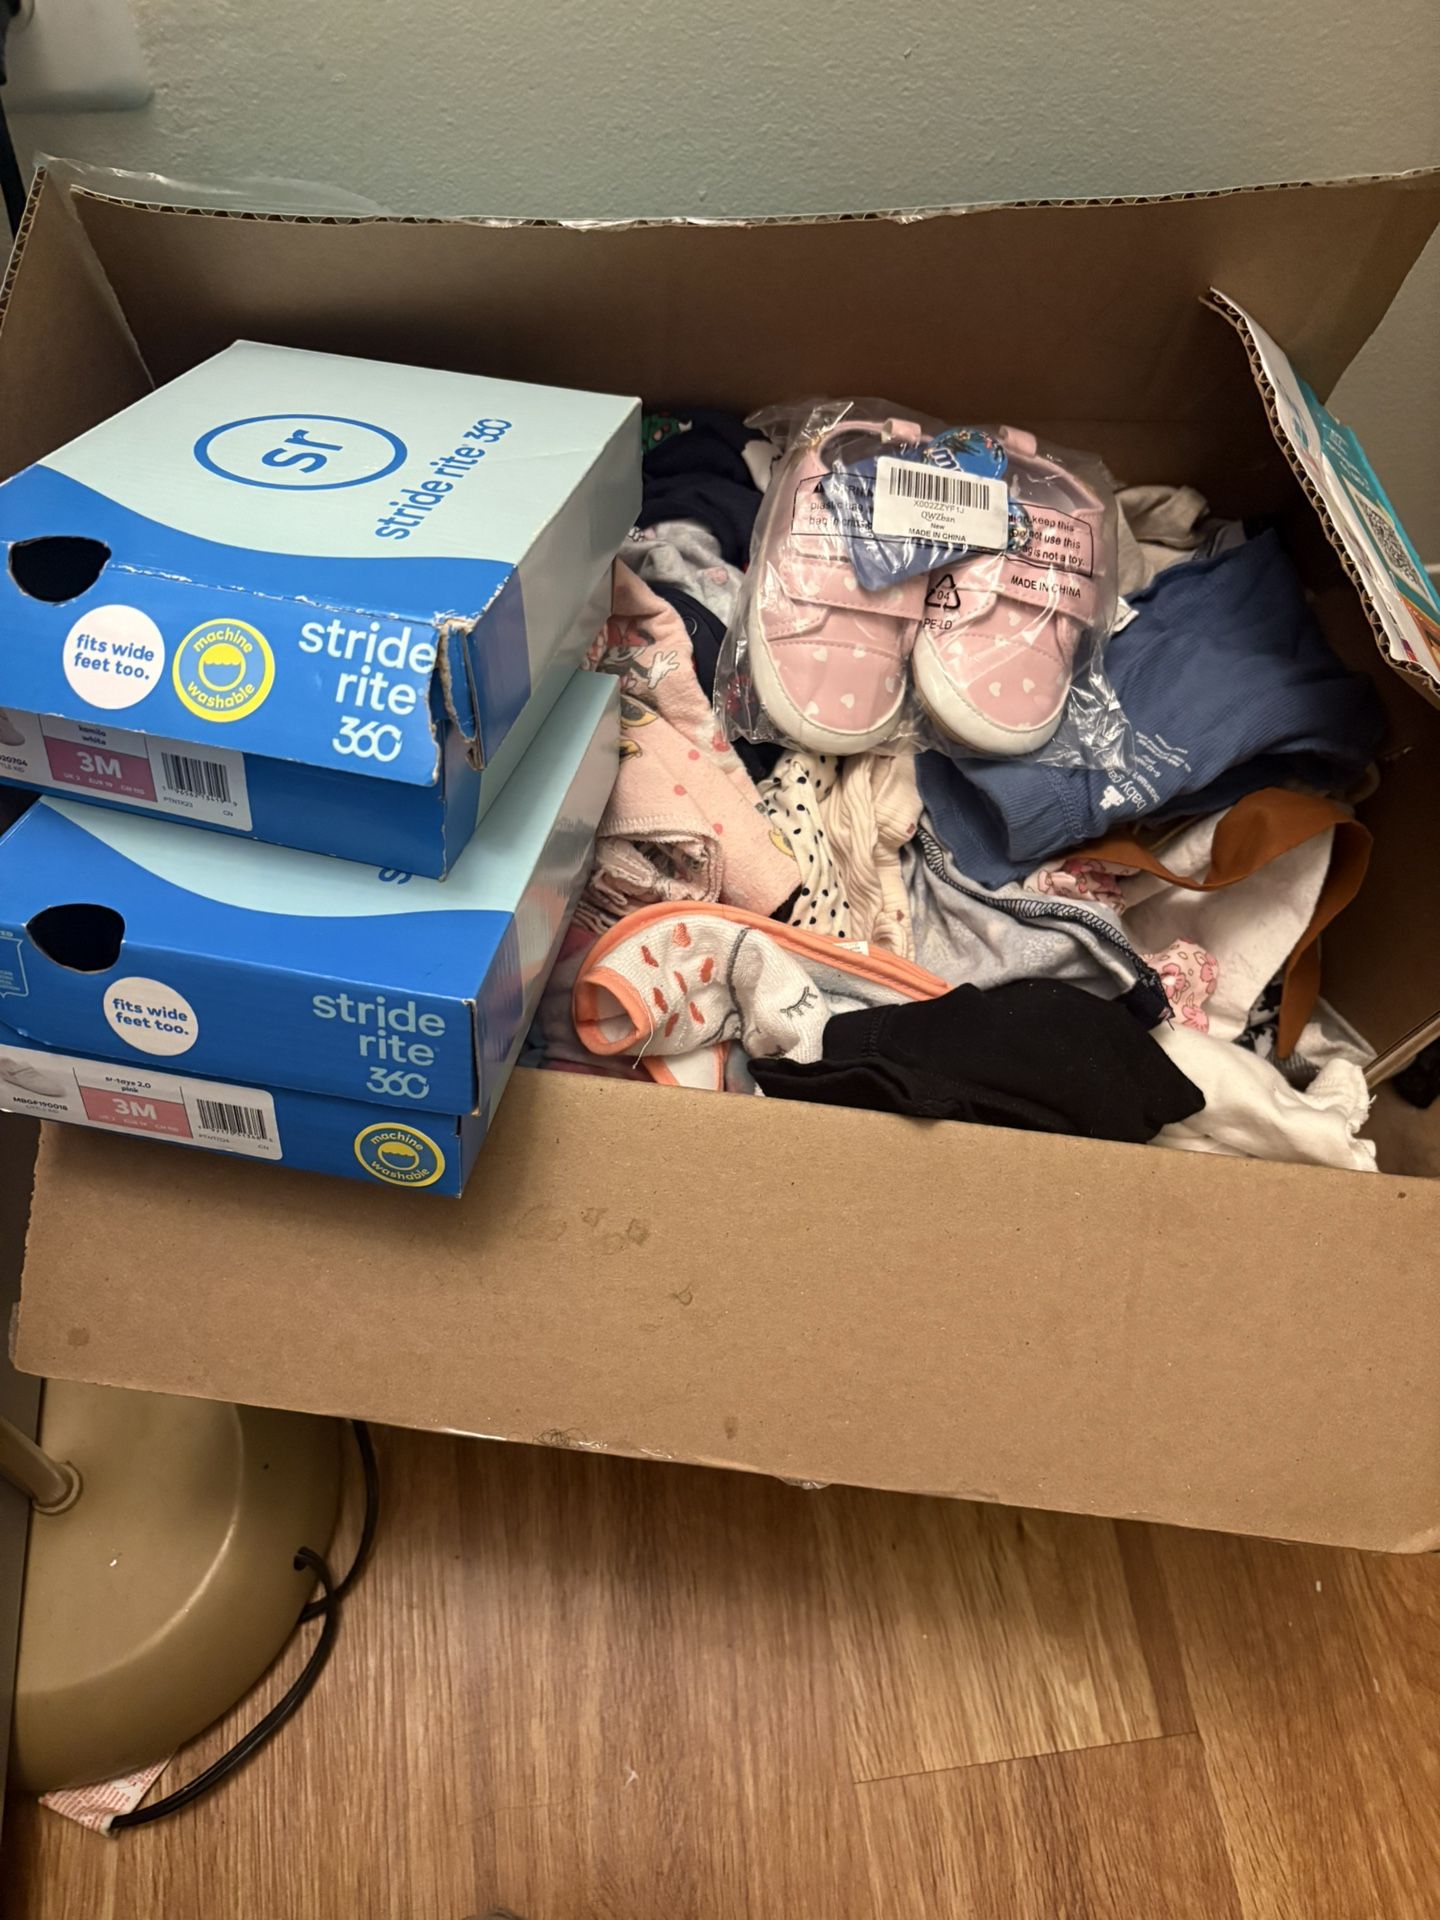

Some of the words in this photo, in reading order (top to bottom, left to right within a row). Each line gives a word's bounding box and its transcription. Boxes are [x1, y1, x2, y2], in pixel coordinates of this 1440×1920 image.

[261, 429, 343, 473] sr
[375, 480, 453, 540] stride
[429, 444, 485, 478] rite
[463, 418, 512, 443] 360
[909, 528, 931, 538] MADE
[942, 532, 966, 542] CHINA
[1032, 516, 1056, 528] keep
[1057, 521, 1074, 532] this
[1033, 547, 1041, 556] is
[1042, 551, 1058, 561] not
[1044, 534, 1061, 545] use
[1063, 538, 1081, 549] this
[1011, 575, 1037, 590] MADE
[1039, 581, 1049, 592] IN
[1051, 583, 1081, 598] CHINA
[923, 617, 953, 630] PE-LD
[76, 634, 107, 653] fits
[112, 643, 154, 662] wide
[193, 627, 254, 654] machine
[298, 618, 437, 673] stride
[74, 652, 110, 672] feet
[115, 661, 150, 680] too.
[187, 682, 255, 709] washable
[335, 665, 416, 715] rite
[332, 715, 402, 762] 360
[76, 751, 122, 780] 3M
[1120, 780, 1147, 813] baby
[112, 997, 143, 1014] fits
[146, 1006, 188, 1021] wide
[312, 993, 446, 1037] stride
[116, 1012, 151, 1028] feet
[154, 1020, 189, 1035] too.
[359, 1029, 435, 1066] rite
[138, 1081, 151, 1089] 2.0
[366, 1066, 429, 1099] 360
[112, 1098, 157, 1120] 3M
[370, 1131, 424, 1151] machine
[371, 1160, 430, 1181] washable
